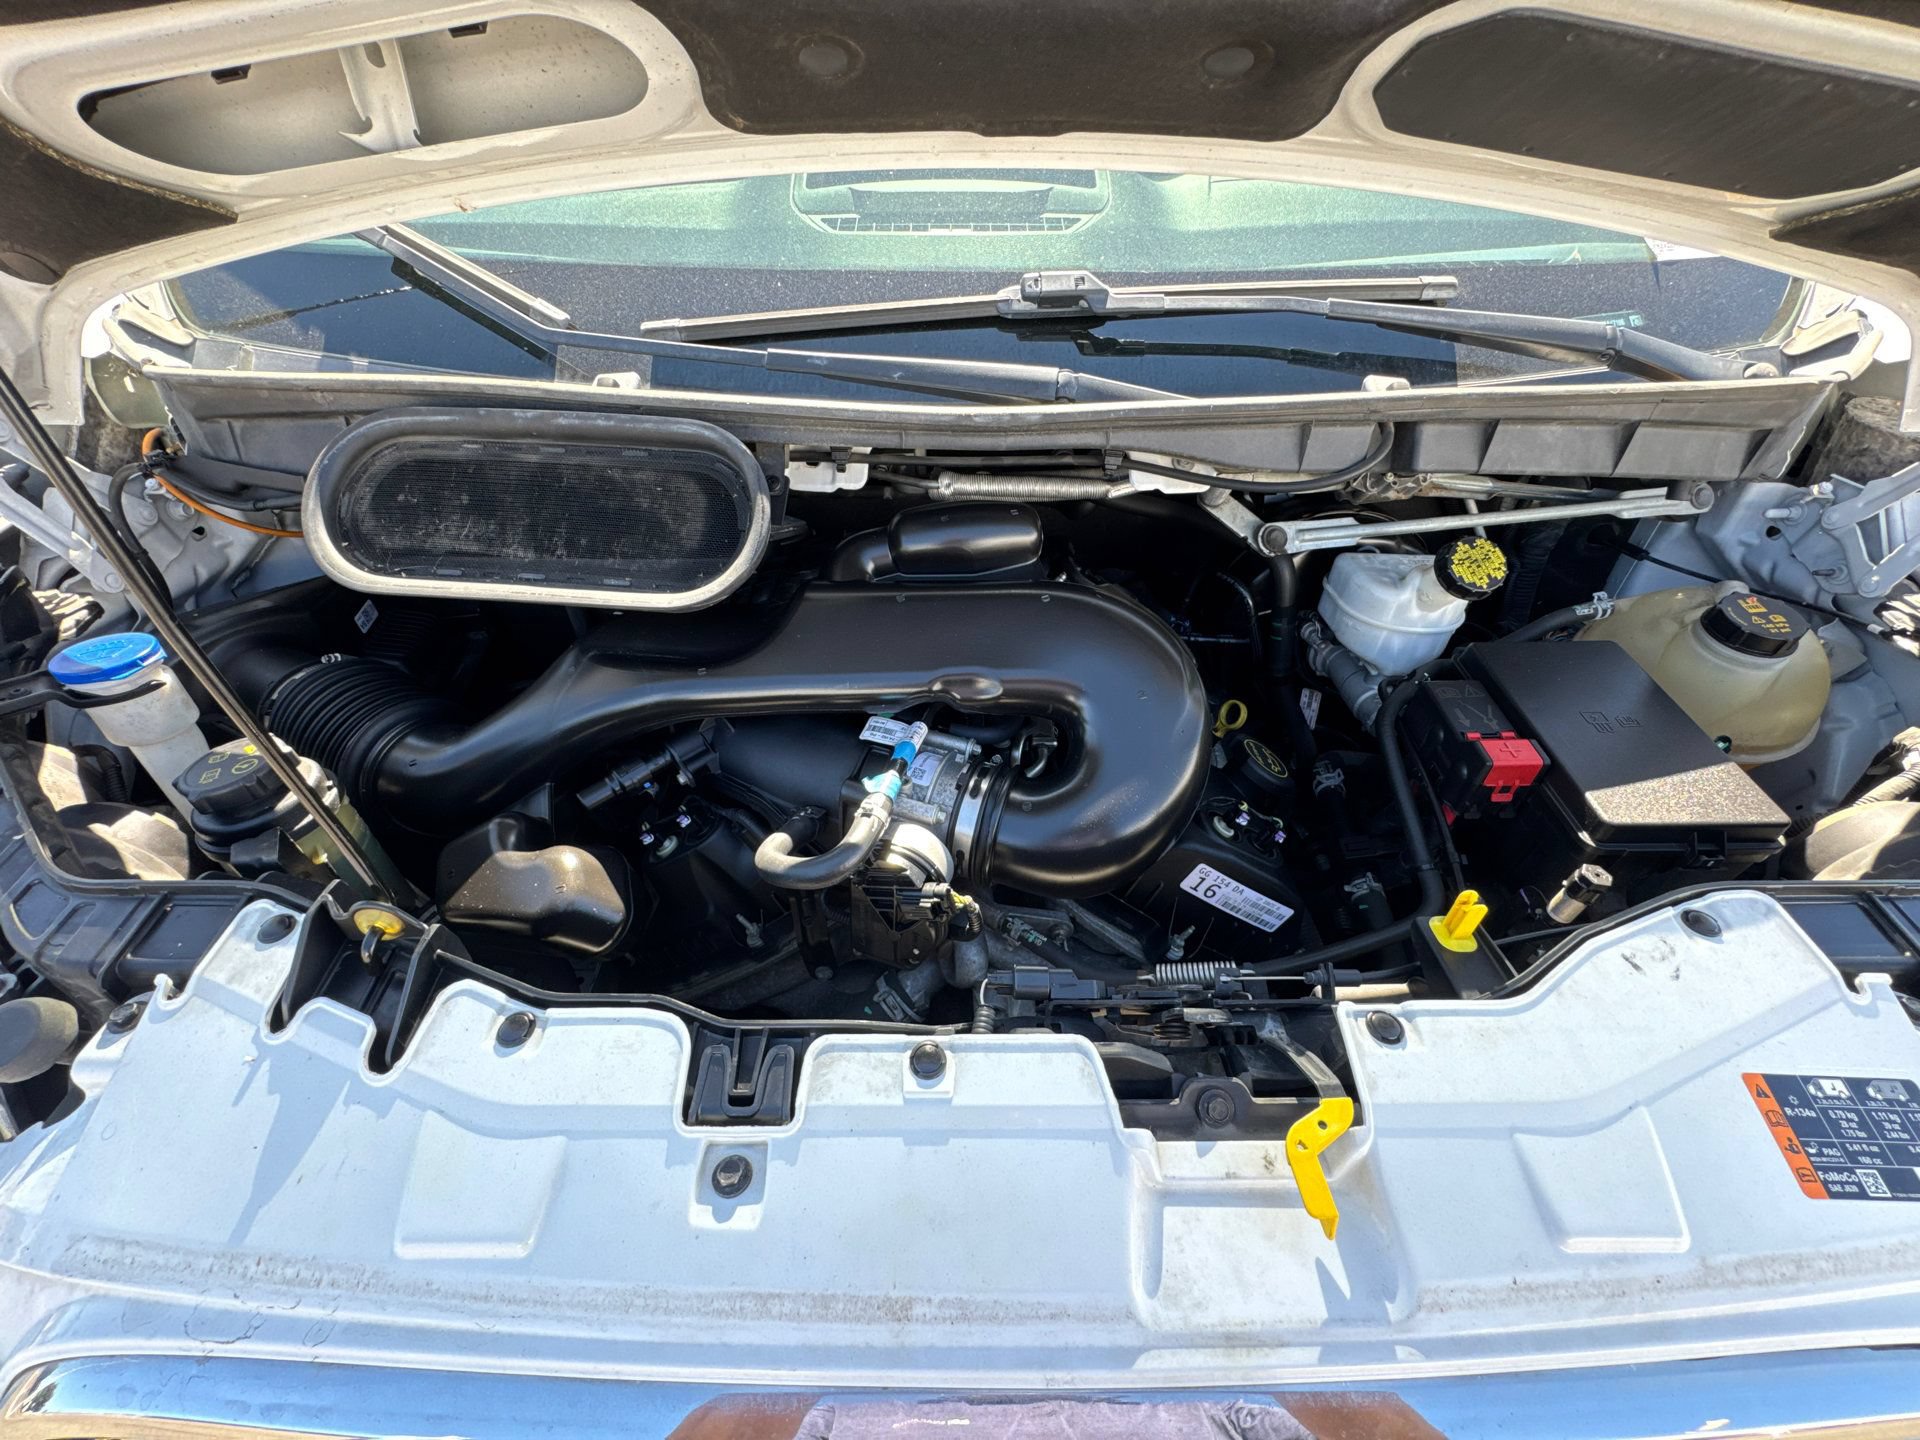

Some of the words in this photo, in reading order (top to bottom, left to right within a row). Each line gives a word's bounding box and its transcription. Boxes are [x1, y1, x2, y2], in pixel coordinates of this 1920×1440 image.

[1199, 867, 1212, 878] GG
[1212, 875, 1231, 888] 154
[1231, 885, 1245, 896] DA
[1189, 876, 1222, 899] 16
[1783, 1107, 1817, 1117] R-134a
[1828, 1109, 1846, 1119] 0.79
[1844, 1110, 1859, 1121] kg
[1872, 1111, 1889, 1120] 1.11
[1887, 1112, 1901, 1123] kg
[1822, 1147, 1841, 1156] PAG
[1817, 1171, 1859, 1182] FoMoCo
[1828, 1183, 1844, 1192] SAE
